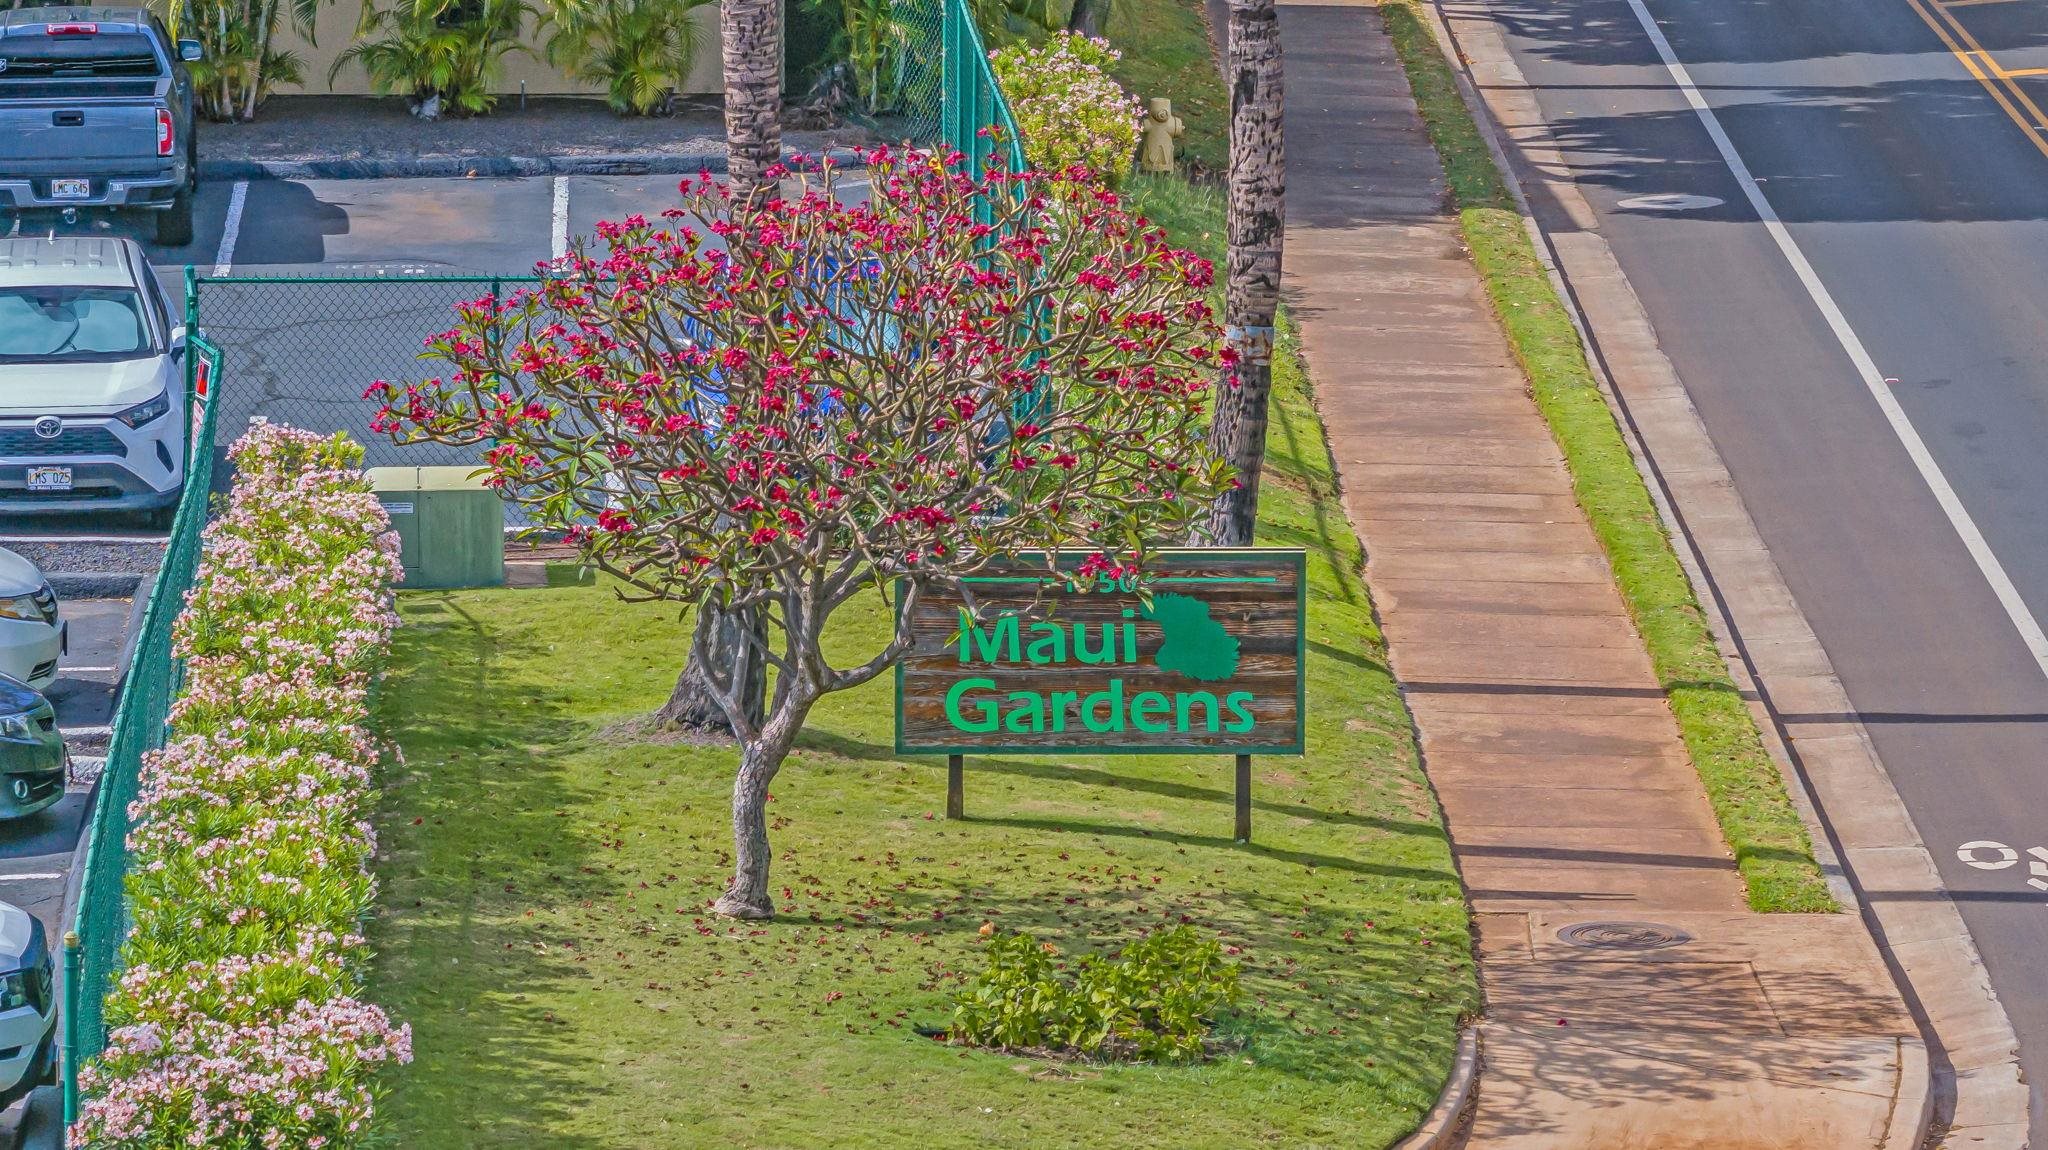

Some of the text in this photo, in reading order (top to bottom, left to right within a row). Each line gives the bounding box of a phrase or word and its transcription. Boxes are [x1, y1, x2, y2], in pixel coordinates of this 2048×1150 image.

[53, 183, 69, 194] LMC
[29, 472, 71, 484] LMS 025
[958, 609, 1137, 663] Maui
[944, 678, 1255, 733] Gardens
